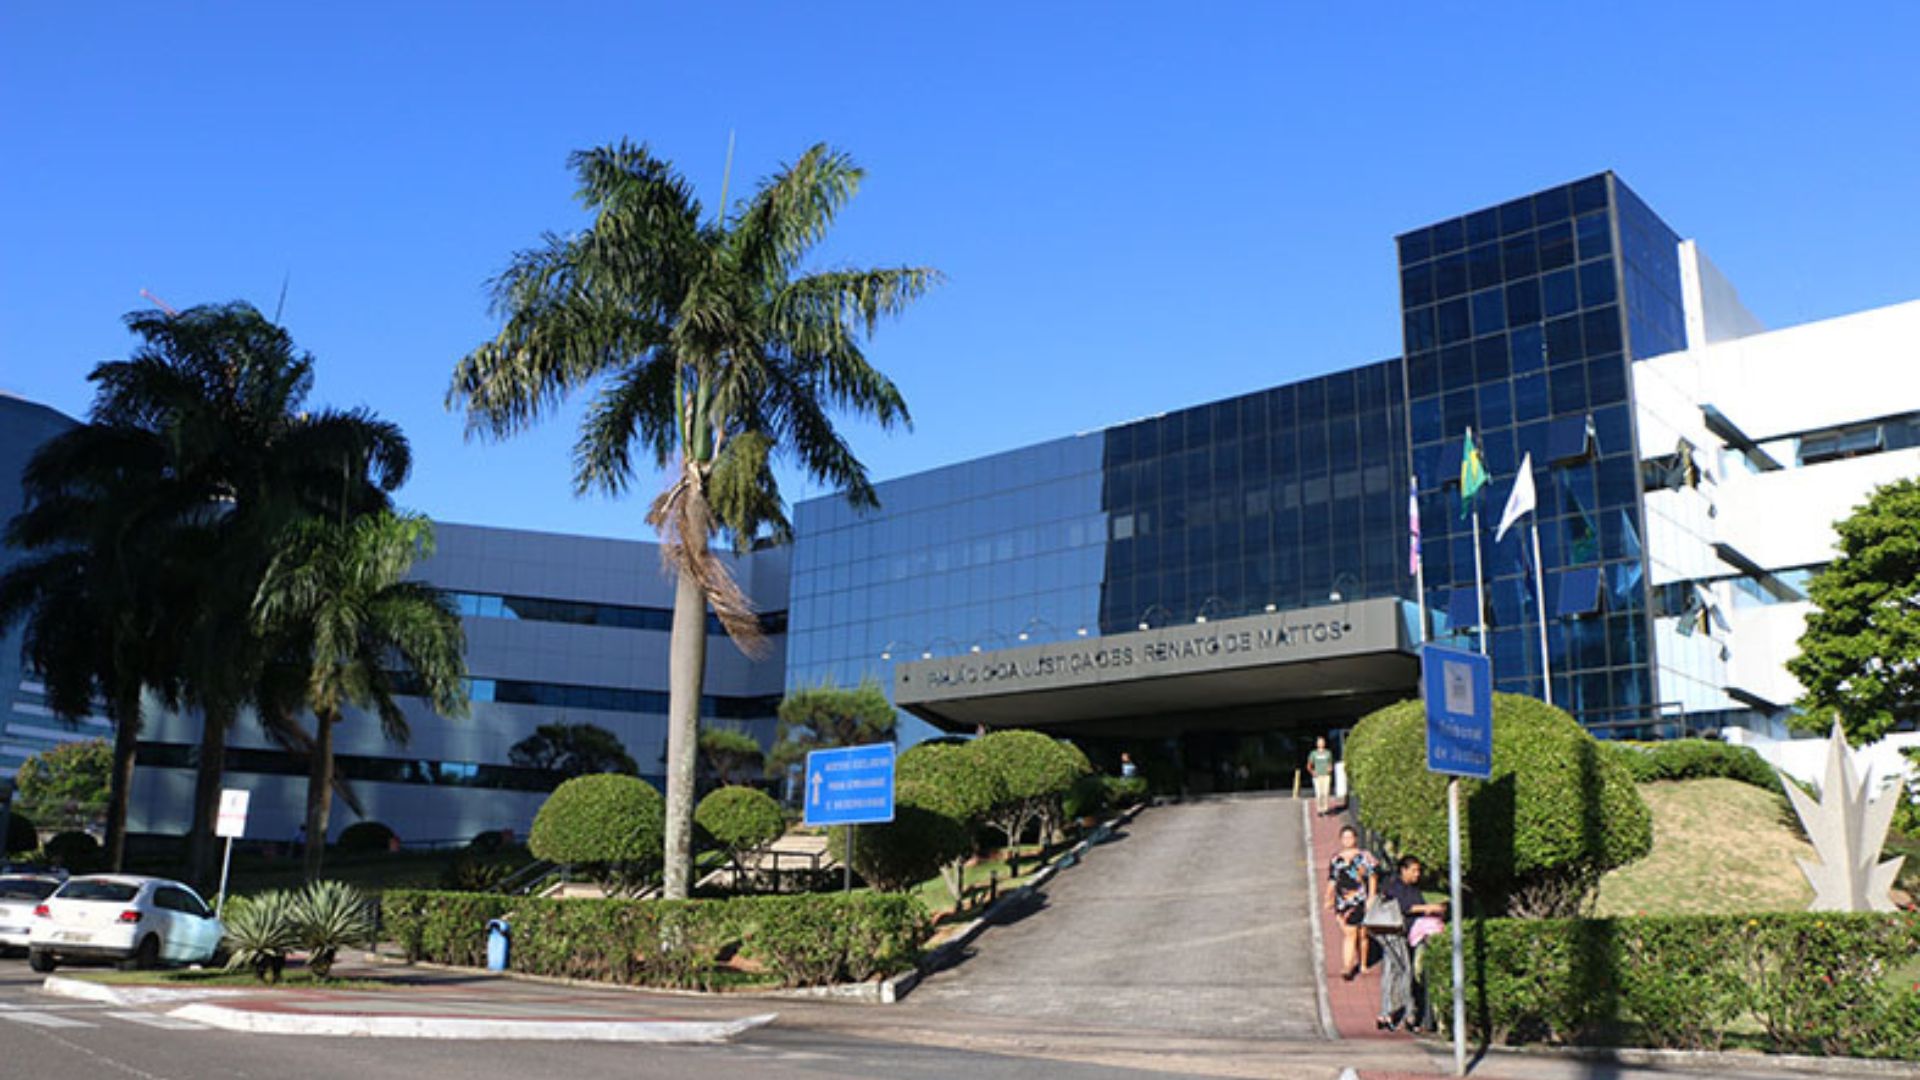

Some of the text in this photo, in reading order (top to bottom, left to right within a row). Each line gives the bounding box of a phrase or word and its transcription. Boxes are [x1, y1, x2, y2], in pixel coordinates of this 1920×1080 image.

[1144, 635, 1220, 663] RENATO
[1226, 631, 1250, 653] DE
[1258, 620, 1342, 649] MATTOS
